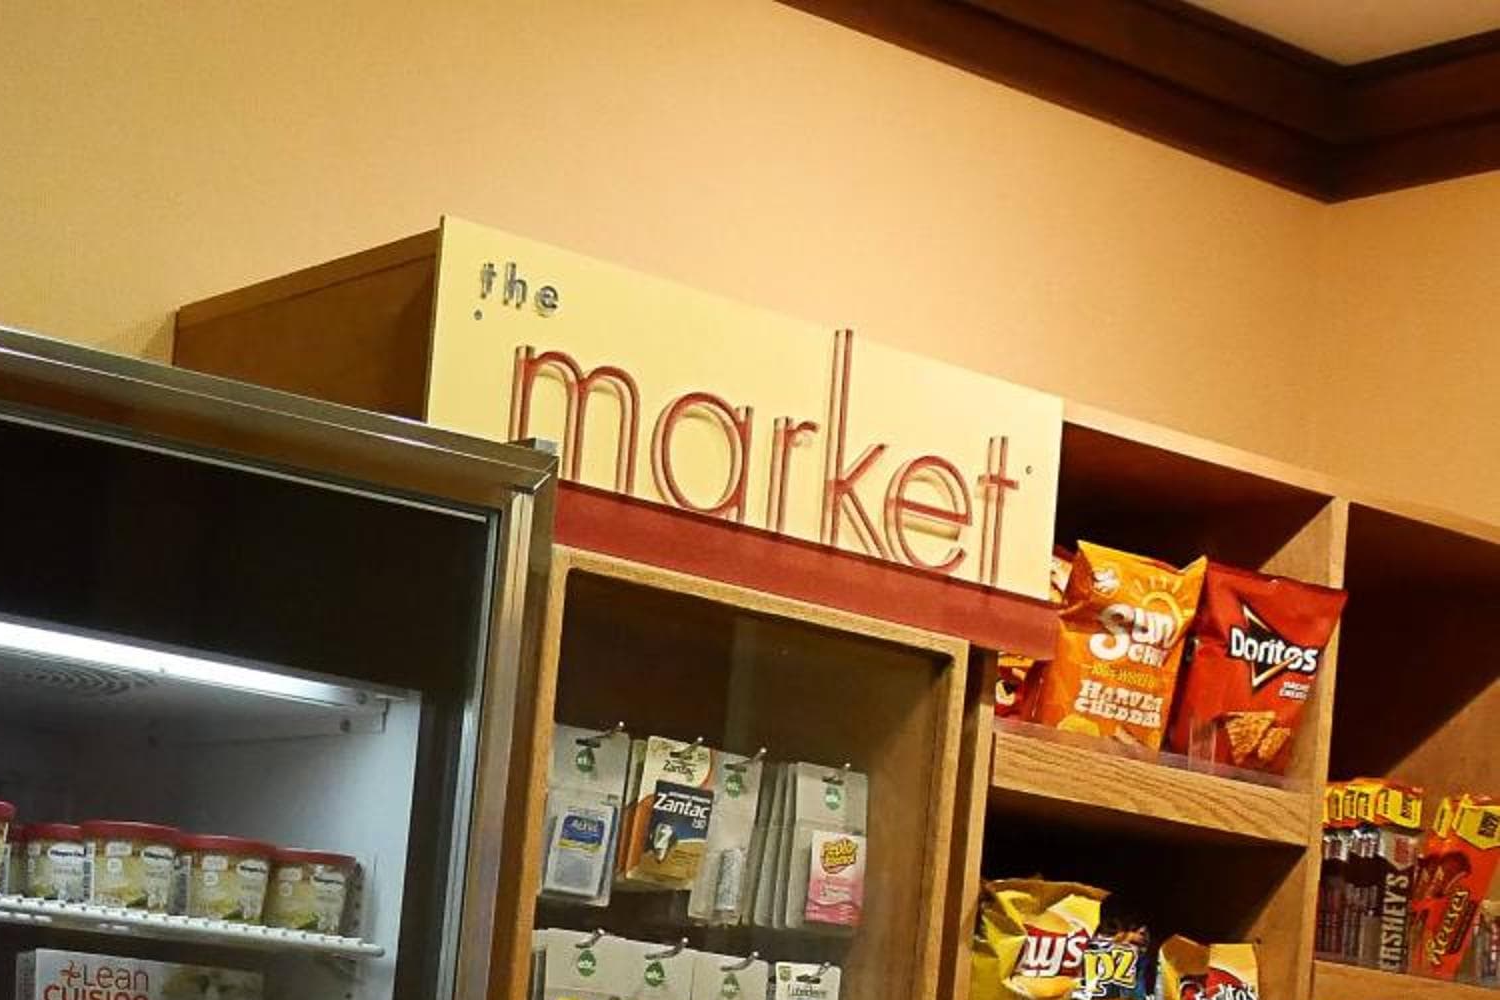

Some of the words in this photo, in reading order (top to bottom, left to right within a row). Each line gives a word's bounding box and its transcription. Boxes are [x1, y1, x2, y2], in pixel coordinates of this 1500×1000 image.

[480, 260, 560, 317] the
[508, 328, 1019, 588] market
[1230, 626, 1319, 673] Doritos
[653, 792, 711, 820] Zantac
[1379, 872, 1410, 972] ERSHEY'S
[82, 963, 150, 992] Lean
